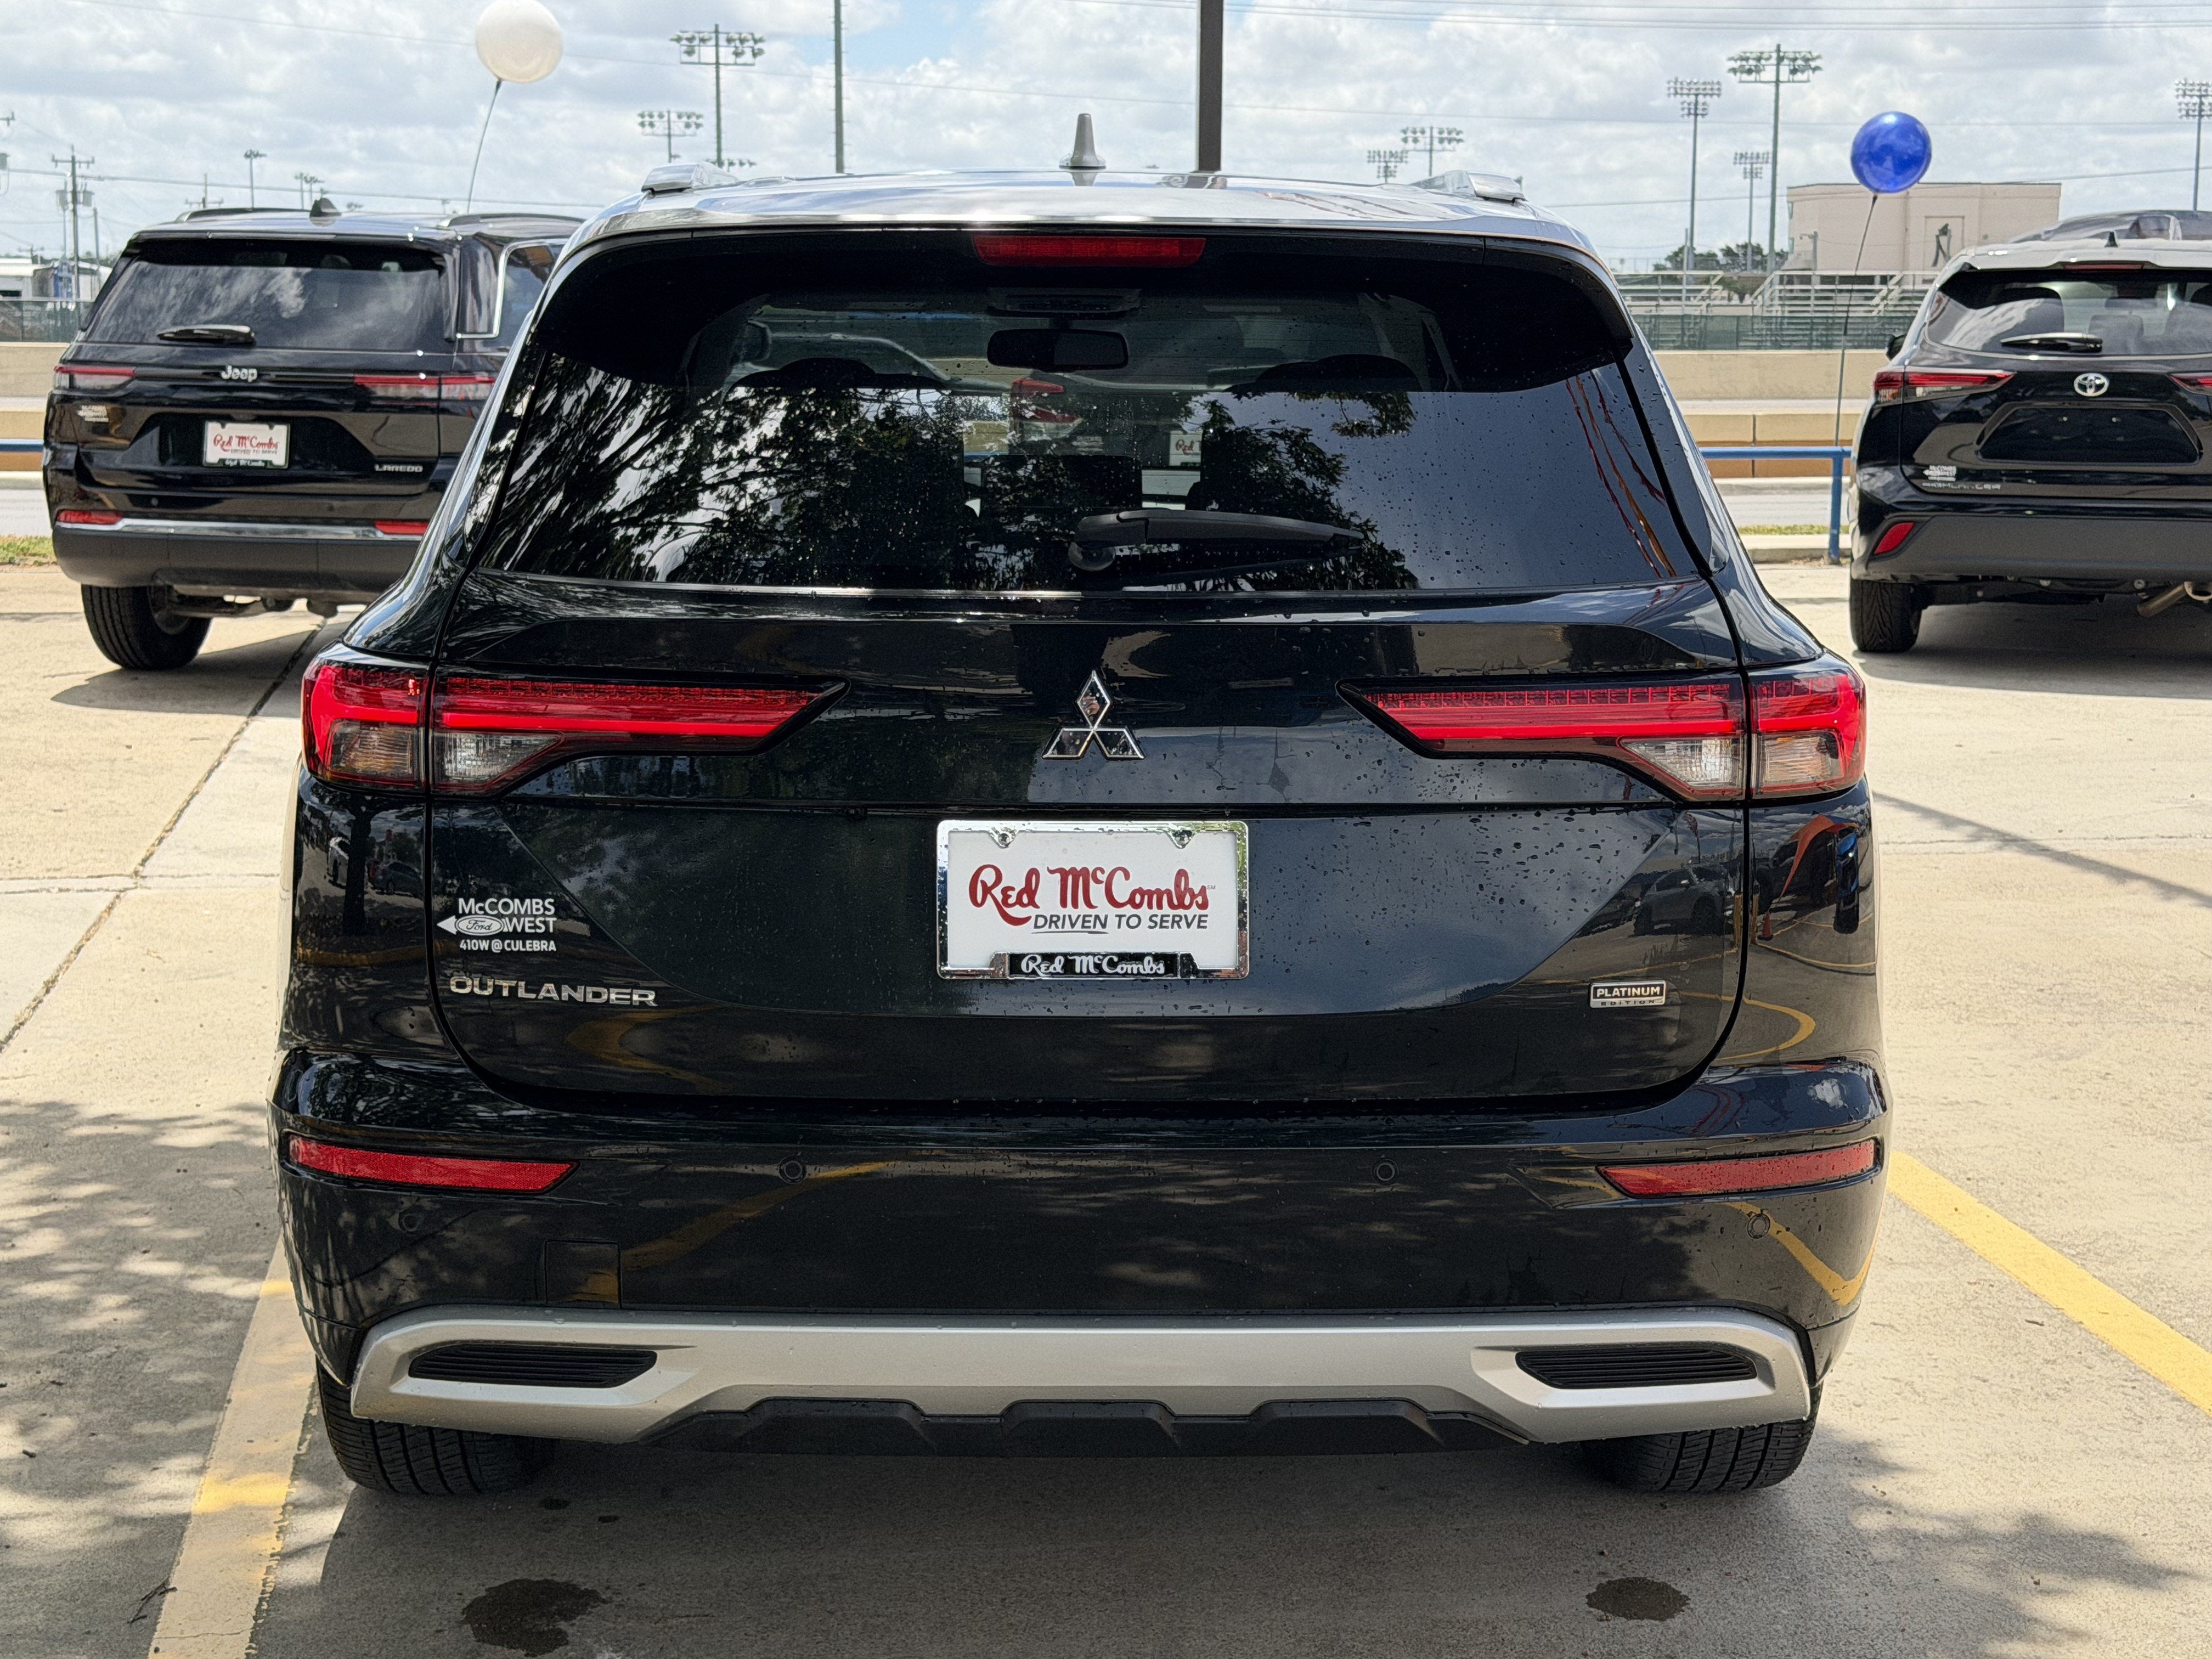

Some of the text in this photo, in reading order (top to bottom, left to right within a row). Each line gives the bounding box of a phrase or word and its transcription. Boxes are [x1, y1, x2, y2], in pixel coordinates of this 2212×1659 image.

[221, 365, 257, 382] Jeep
[213, 433, 278, 452] Red McCombs
[968, 864, 1040, 926] Red
[1047, 866, 1209, 911] McCombs
[458, 898, 555, 915] McCOMBS
[506, 917, 557, 933] WEST
[1033, 914, 1209, 930] DRIVEN TO SERVE
[504, 939, 557, 952] CULEBRA
[1021, 954, 1165, 977] Red McCombs
[450, 976, 658, 1006] OUTLANDER
[1596, 986, 1661, 998] PLATINUM
